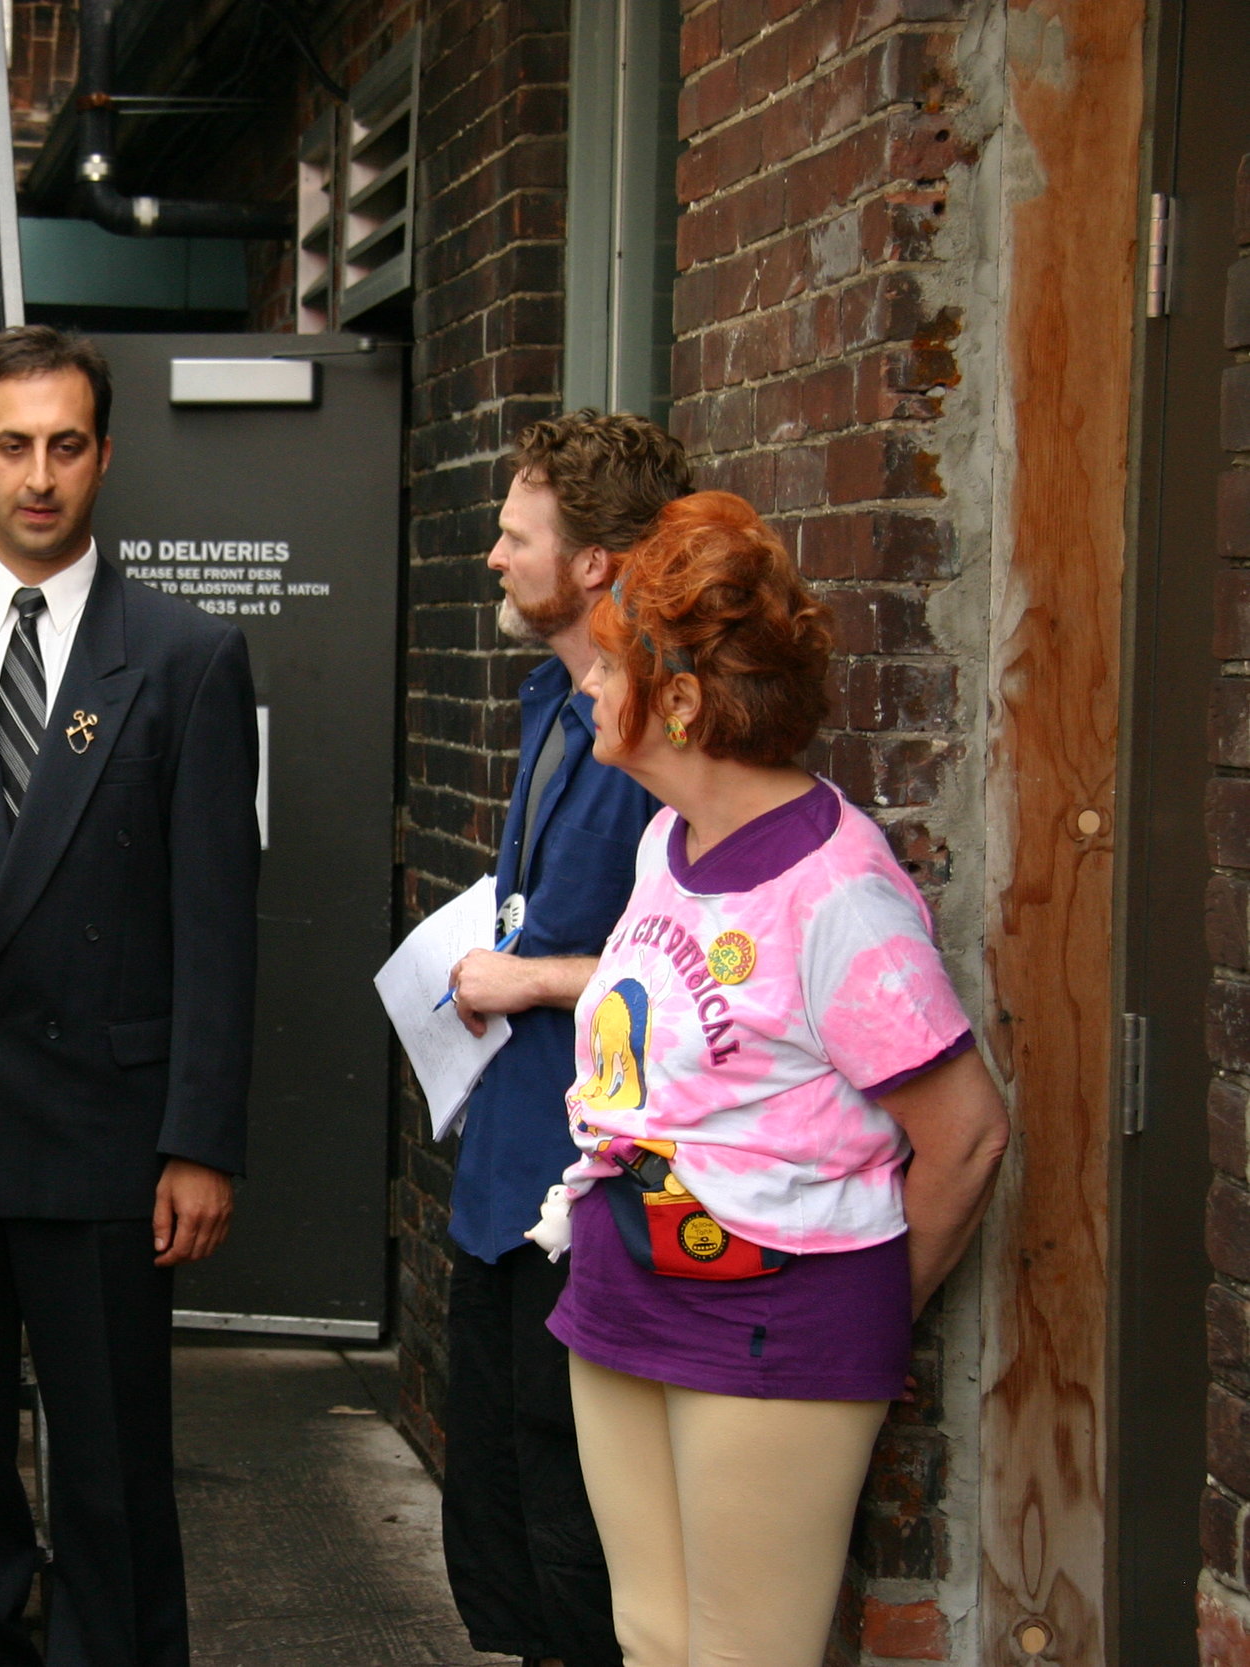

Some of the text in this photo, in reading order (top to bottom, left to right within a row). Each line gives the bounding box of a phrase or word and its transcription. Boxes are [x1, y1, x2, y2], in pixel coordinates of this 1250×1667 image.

[119, 541, 290, 562] NO DELIVERIES
[126, 567, 282, 580] PLEASE SEE FRONT DESK
[161, 581, 178, 594] TO
[180, 582, 255, 596] GLADSTONE
[256, 583, 285, 596] AVE.
[288, 584, 330, 596] HATCH
[240, 601, 266, 615] ext
[269, 601, 281, 615] 0
[630, 914, 741, 1067] GET PHYSICAL
